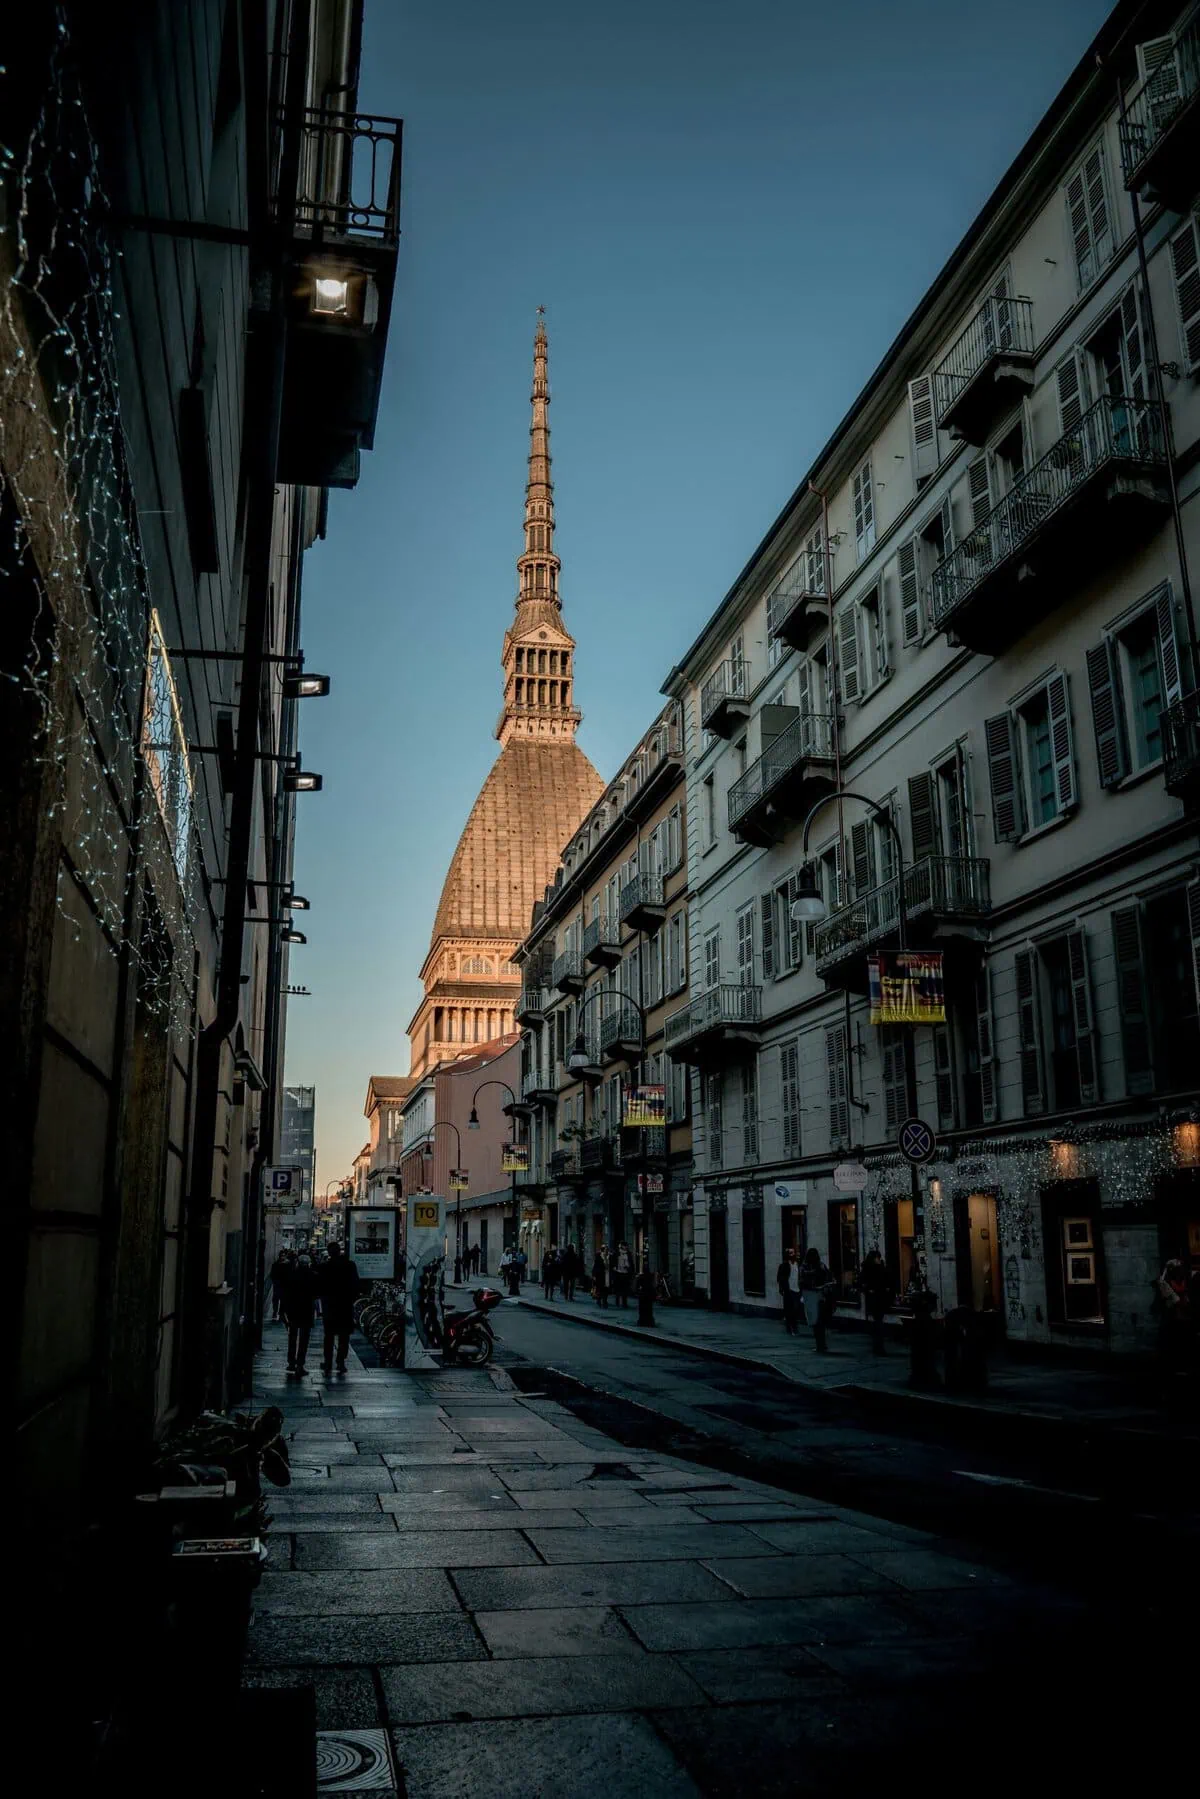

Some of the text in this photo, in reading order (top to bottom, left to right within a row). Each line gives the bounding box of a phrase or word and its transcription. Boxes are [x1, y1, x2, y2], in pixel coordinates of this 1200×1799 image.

[880, 975, 921, 985] Camera
[276, 1172, 289, 1188] P
[417, 1206, 436, 1219] TO
